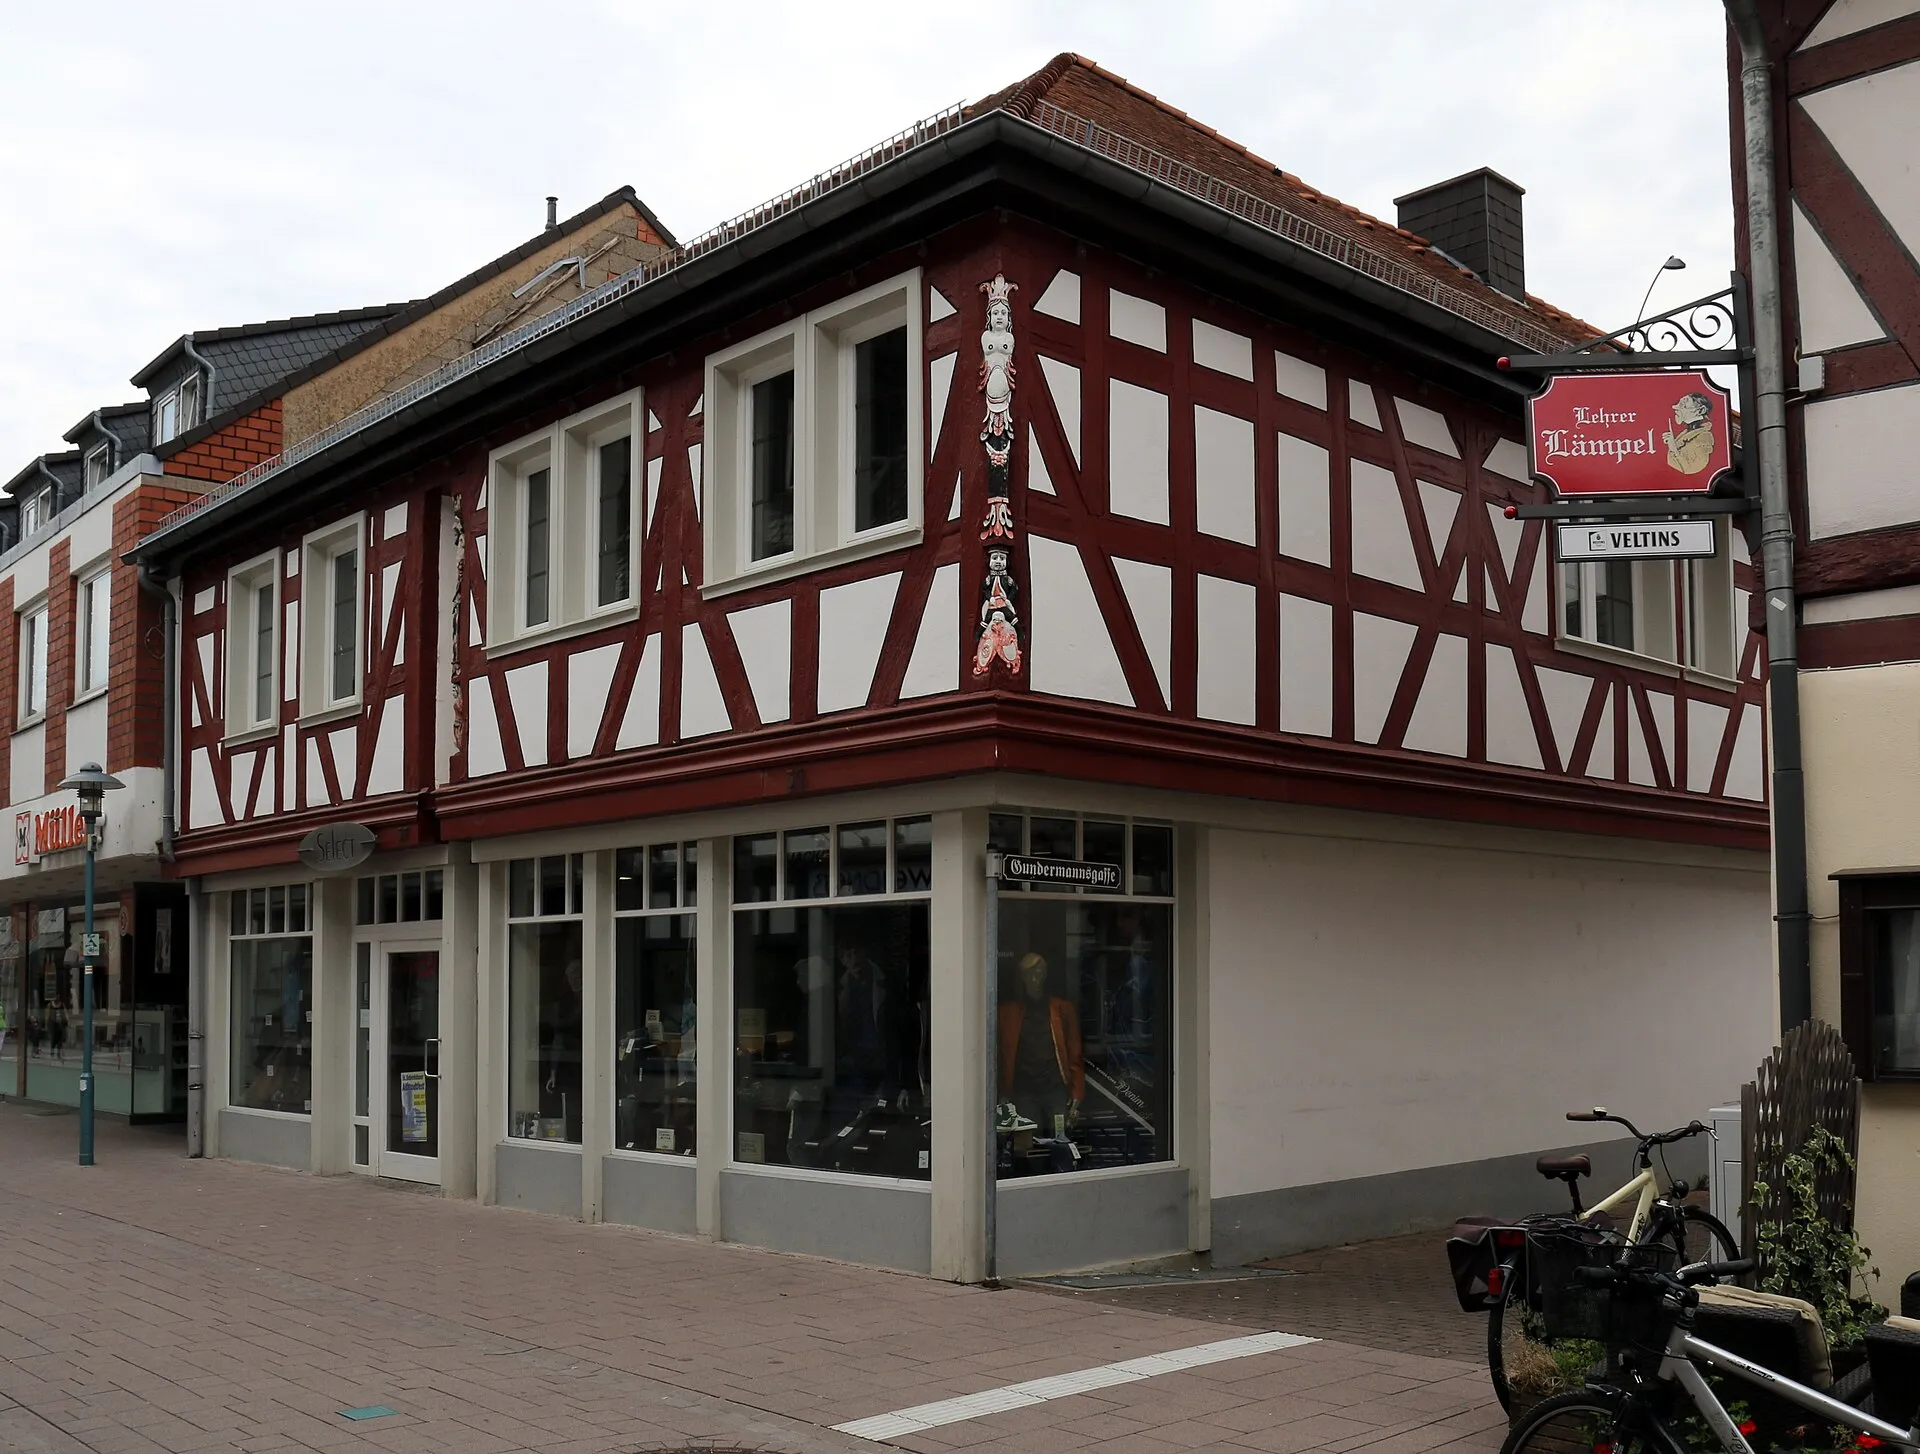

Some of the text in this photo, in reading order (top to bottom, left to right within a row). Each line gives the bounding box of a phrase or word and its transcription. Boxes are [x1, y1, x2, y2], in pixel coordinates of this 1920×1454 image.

[1572, 406, 1637, 429] Lehrer
[1541, 428, 1657, 466] Lämpel
[1610, 530, 1681, 549] VELTINS
[34, 804, 87, 856] Mülle
